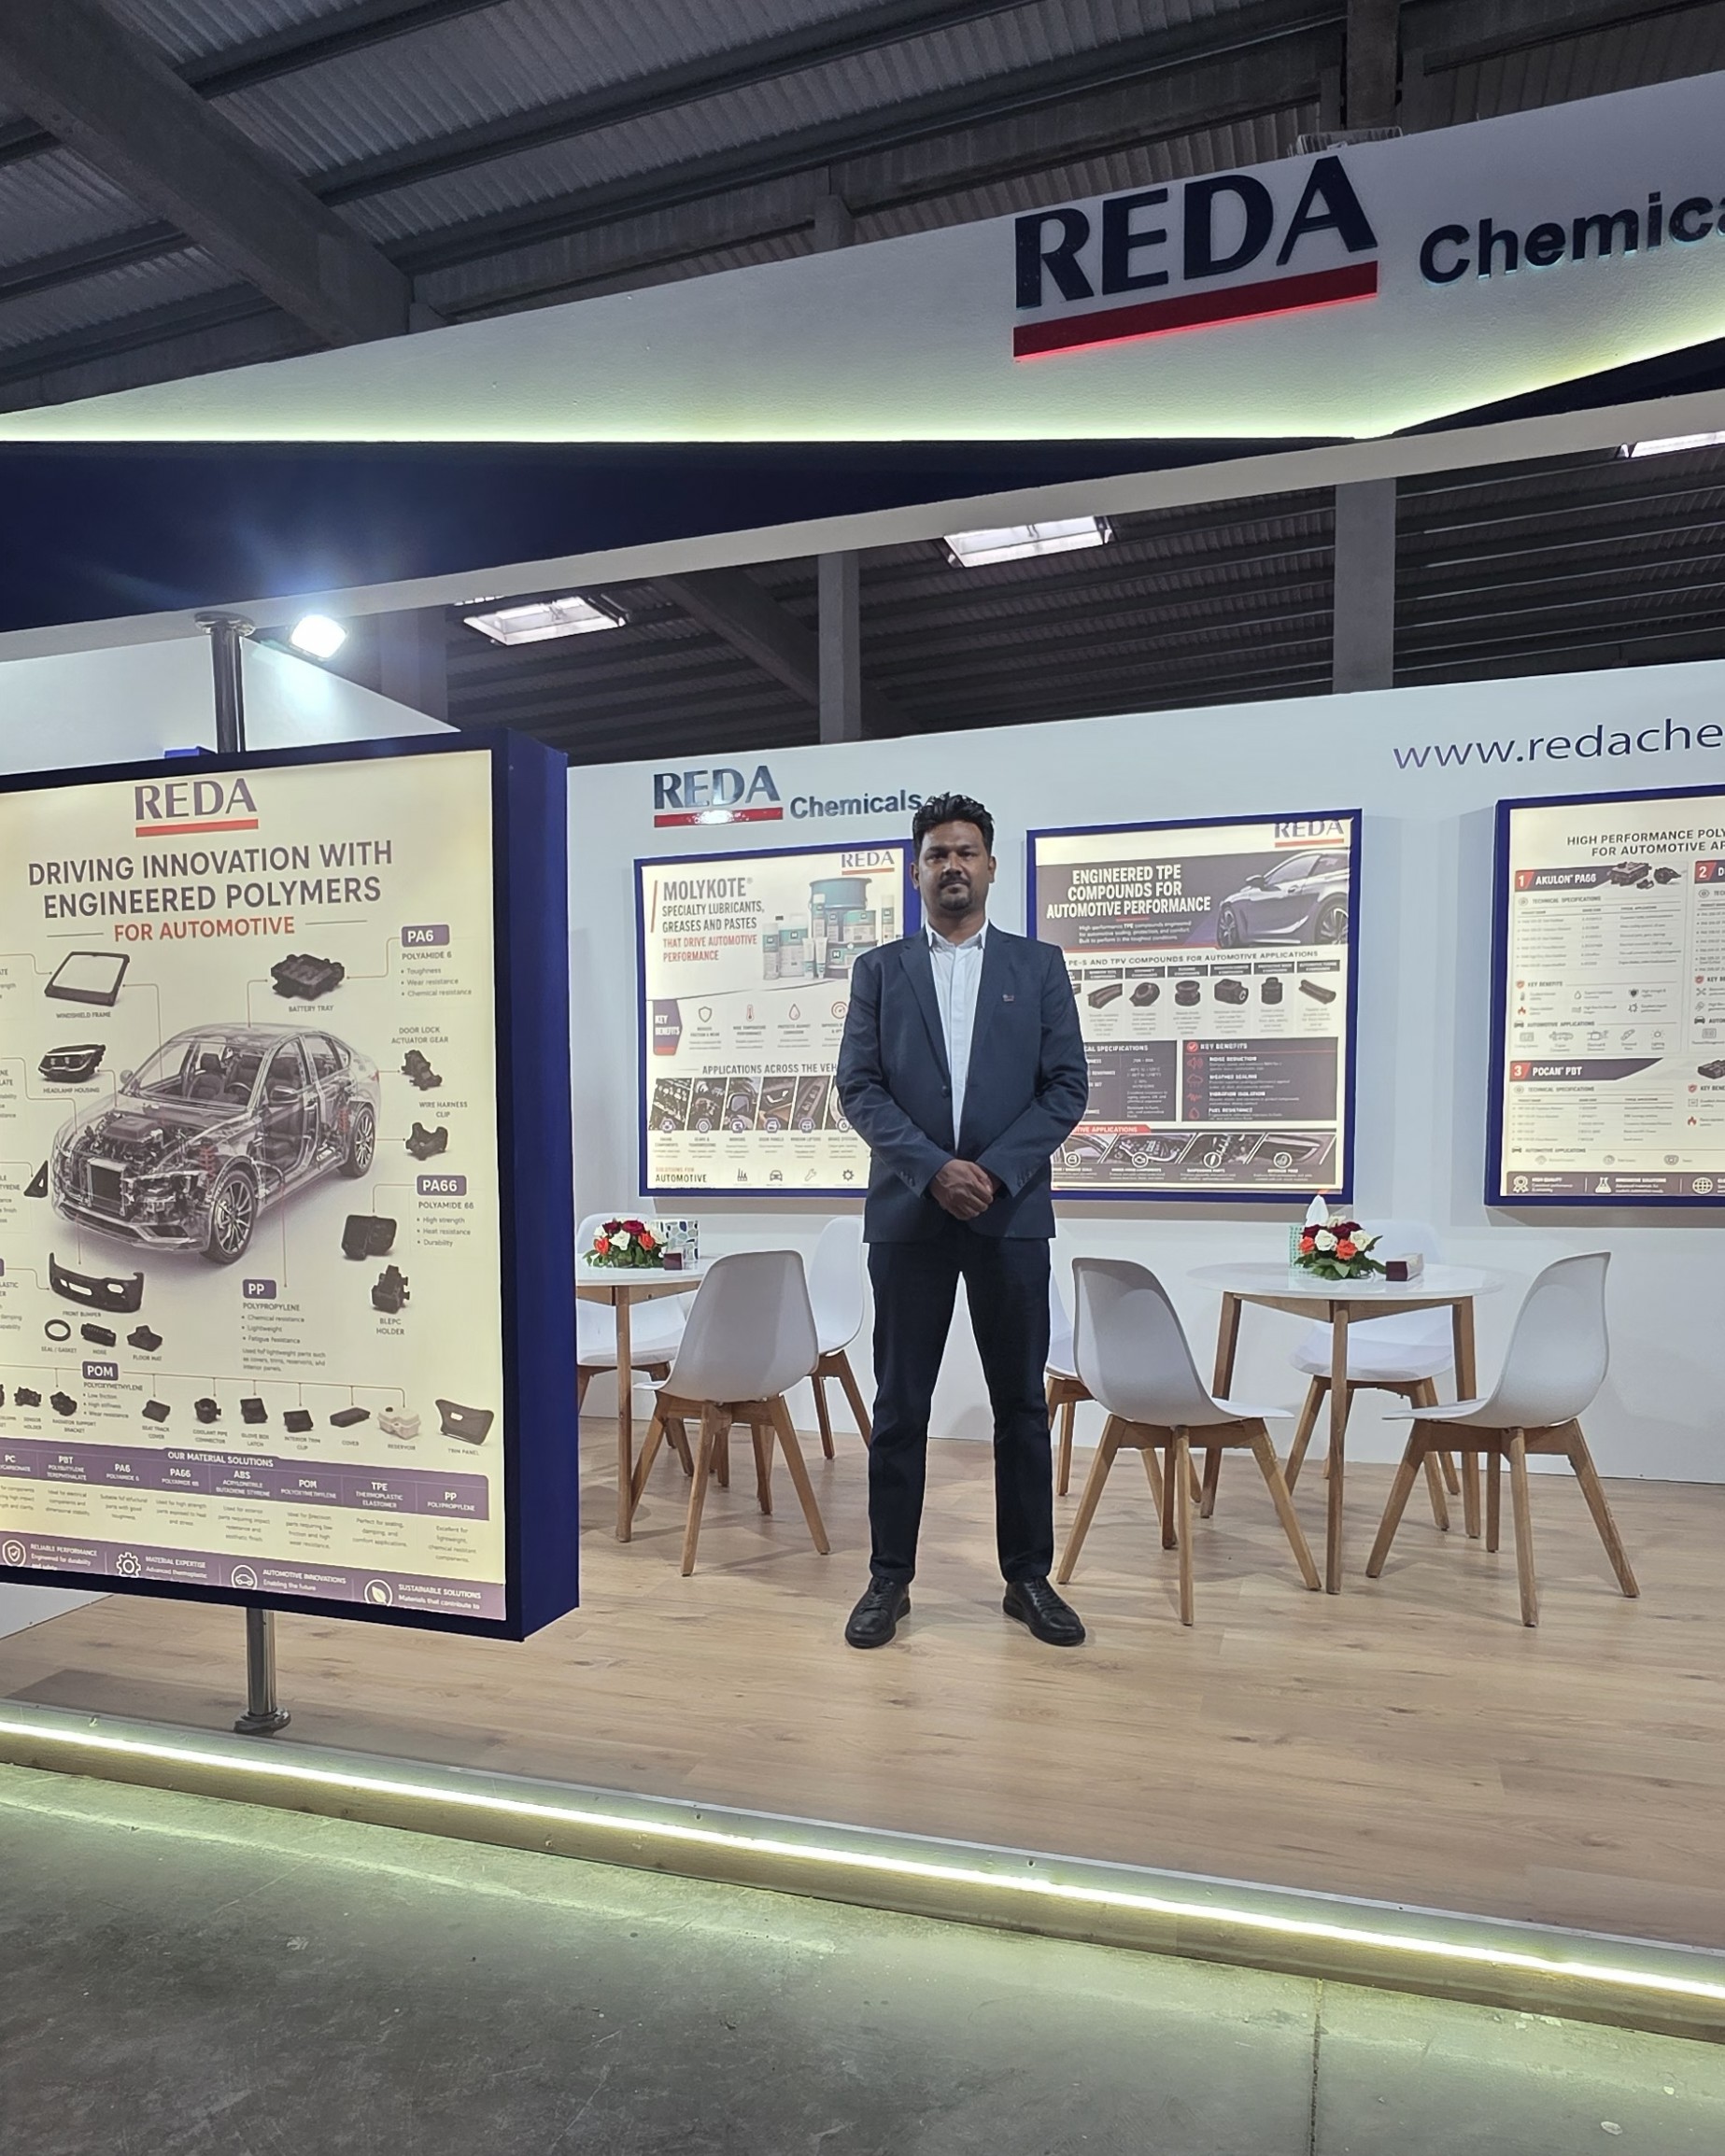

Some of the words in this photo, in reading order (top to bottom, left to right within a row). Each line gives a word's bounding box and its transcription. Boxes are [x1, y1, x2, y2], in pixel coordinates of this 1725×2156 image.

[1015, 156, 1379, 310] REDA
[1421, 190, 1725, 283] Chemic
[1393, 717, 1723, 768] www.redache
[654, 765, 781, 810] REDA
[790, 789, 922, 819] Chemicals
[134, 778, 257, 821] REDA
[1274, 820, 1344, 838] REDA
[1567, 836, 1598, 846] HIGH
[1600, 829, 1693, 844] PERFORMANCE
[1591, 847, 1617, 857] FOR
[1620, 841, 1706, 855] AUTOMOTIVE
[29, 856, 134, 886] DRIVING
[143, 845, 309, 879] INNOVATION
[318, 840, 392, 868] WITH
[841, 851, 895, 867] REDA
[1072, 867, 1153, 885] ENGINEERED
[1155, 864, 1181, 880] TPE
[1699, 866, 1707, 879] 2
[1518, 874, 1525, 887] 1
[1574, 873, 1597, 883] PA66
[44, 885, 216, 919] ENGINEERED
[226, 876, 381, 909] POLYMERS
[1068, 883, 1152, 901] COMPOUNDS
[1155, 881, 1182, 896] FOR
[662, 903, 707, 918] SPECIALTY
[708, 900, 765, 915] LUBRICANTS,
[1046, 902, 1122, 919] AUTOMOTIVE
[1124, 896, 1211, 915] PERFORMANCE
[114, 923, 153, 942] FOR
[159, 916, 295, 940] AUTOMOTIVE
[662, 920, 701, 933] GREASES
[702, 919, 721, 932] AND
[723, 917, 757, 930] PASTES
[407, 929, 434, 943] PA6
[663, 937, 682, 948] THAT
[683, 937, 706, 948] DRIVE
[708, 935, 757, 947] AUTOMOTIVE
[402, 951, 444, 960] POLYAMIDE
[446, 951, 452, 959] 6
[663, 950, 719, 963] PERFORMANCE
[1128, 956, 1184, 965] COMPOUNDS
[1204, 952, 1257, 962] AUTOMOTIVE
[1260, 951, 1319, 959] APPLICATIONS
[406, 967, 442, 976] Toughness
[1096, 1044, 1149, 1052] SPECIFICATIONS
[702, 1064, 762, 1075] APPLICATIONS
[764, 1064, 799, 1074] ACROSS
[801, 1064, 817, 1073] THE
[1514, 1064, 1522, 1077] 3
[656, 1174, 707, 1183] AUTOMOTIVE
[422, 1179, 458, 1192] PA66
[418, 1201, 462, 1209] POLYAMIDE
[248, 1283, 265, 1295] PP
[243, 1303, 300, 1311] POLYPROPYLENE
[87, 1365, 114, 1377] POM
[5, 1455, 16, 1463] PC
[58, 1456, 73, 1464] PBT
[168, 1451, 185, 1459] OUR
[187, 1453, 226, 1463] MATERIAL
[227, 1457, 274, 1467] SOLUTIONS
[114, 1463, 131, 1473] PA6
[170, 1468, 191, 1478] PA66
[233, 1470, 251, 1479] ABS
[298, 1479, 317, 1488] POM
[371, 1482, 388, 1491] TPE
[444, 1491, 458, 1501] PP
[427, 1501, 475, 1512] POLYPROPYLENE
[146, 1556, 174, 1566] MATERIAL
[175, 1558, 207, 1569] EXPERTISE
[262, 1569, 303, 1580] AUTOMOTIVE
[304, 1573, 346, 1585] INNOVATIONS
[398, 1583, 442, 1595] SUSTAINABLE
[443, 1587, 482, 1599] SOLUTIONS
